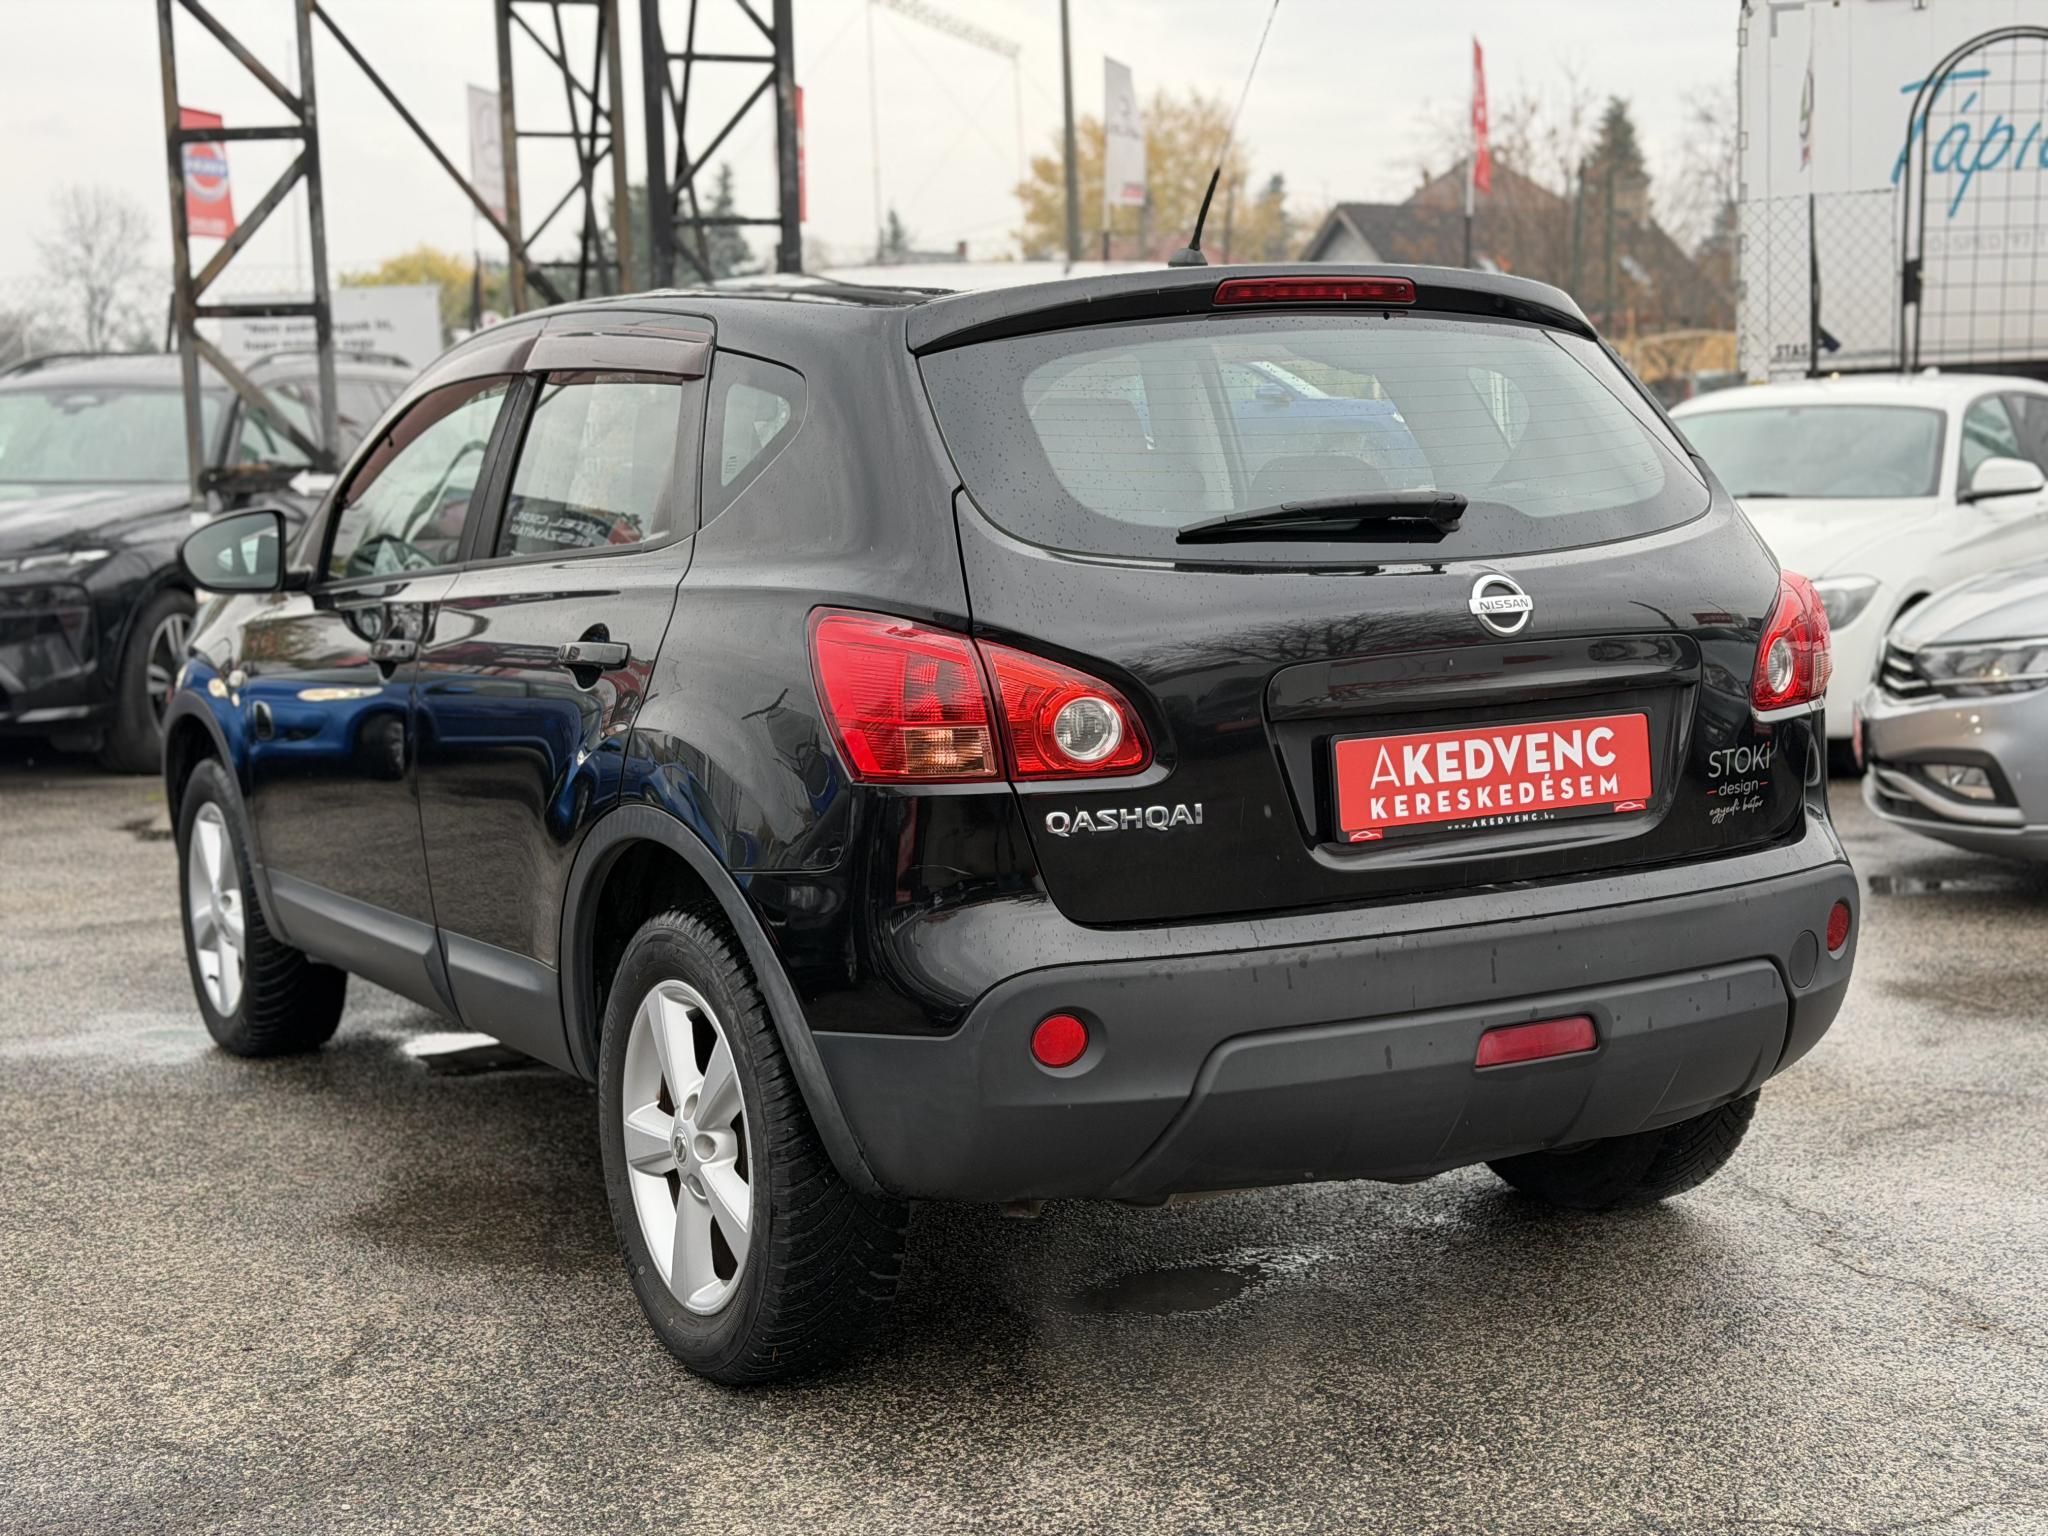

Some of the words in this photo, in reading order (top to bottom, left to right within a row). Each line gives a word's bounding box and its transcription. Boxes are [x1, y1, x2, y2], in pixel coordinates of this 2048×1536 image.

[1479, 598, 1529, 611] NISSAN
[1370, 772, 1619, 820] KERESKEDÉSEM
[1718, 779, 1759, 796] design
[1045, 803, 1203, 837] QASHQAI
